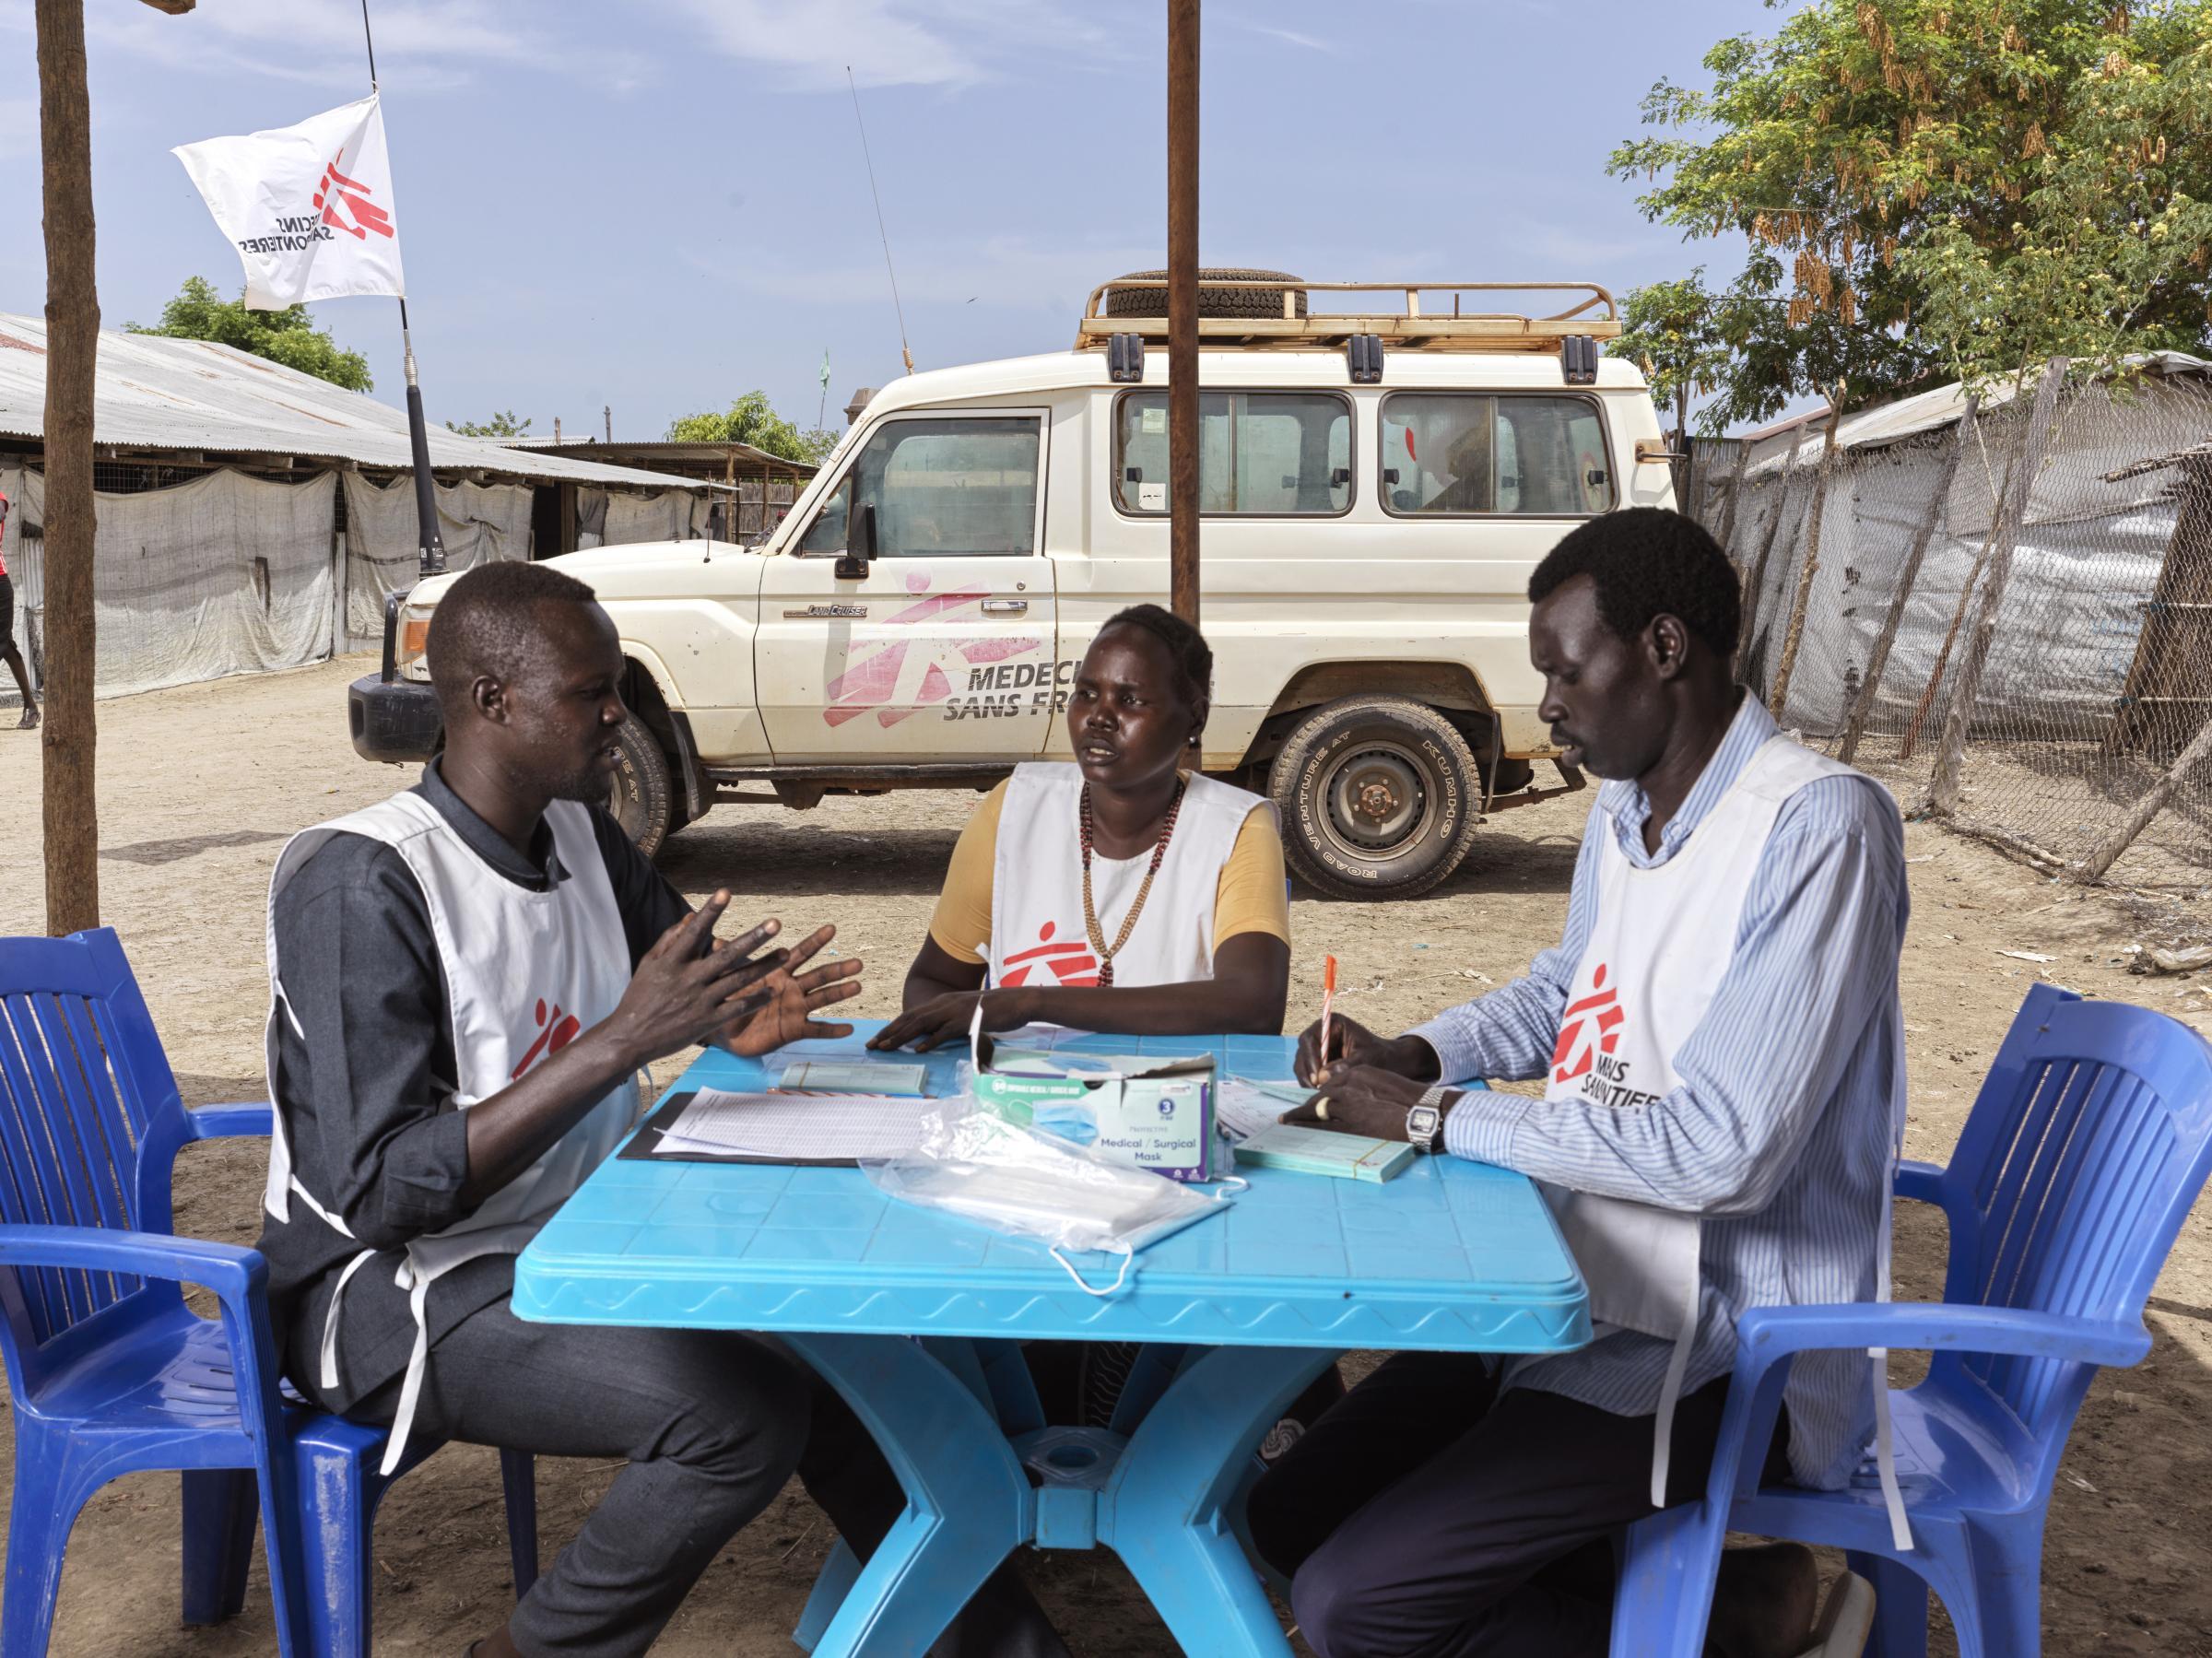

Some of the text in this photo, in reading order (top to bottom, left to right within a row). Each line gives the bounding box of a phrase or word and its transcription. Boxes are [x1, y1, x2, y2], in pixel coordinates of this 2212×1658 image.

[969, 660, 1084, 691] MEDECI
[944, 690, 1076, 721] SANS FR
[1300, 747, 1328, 850] VENTURE
[1422, 740, 1457, 839] KUMHO
[1323, 852, 1378, 879] ROAD
[1161, 1100, 1172, 1114] 3
[1100, 1138, 1142, 1148] Medical
[1153, 1138, 1196, 1150] Surgical
[1135, 1152, 1162, 1161] Mask
